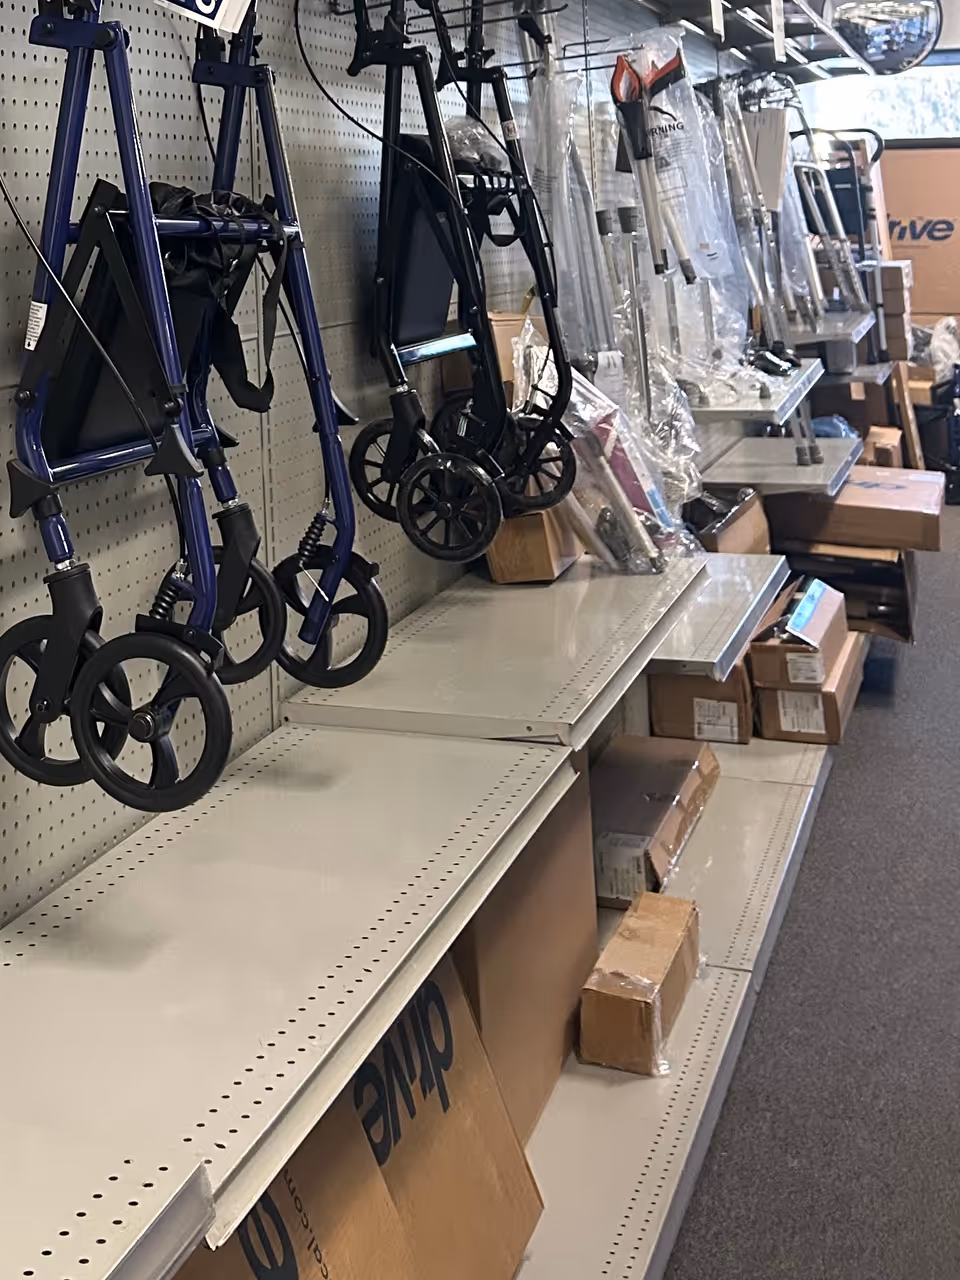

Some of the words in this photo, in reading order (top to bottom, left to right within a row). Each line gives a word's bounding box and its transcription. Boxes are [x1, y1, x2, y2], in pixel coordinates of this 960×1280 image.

[647, 121, 685, 137] RNING
[888, 216, 955, 242] rive
[353, 979, 454, 1166] drive
